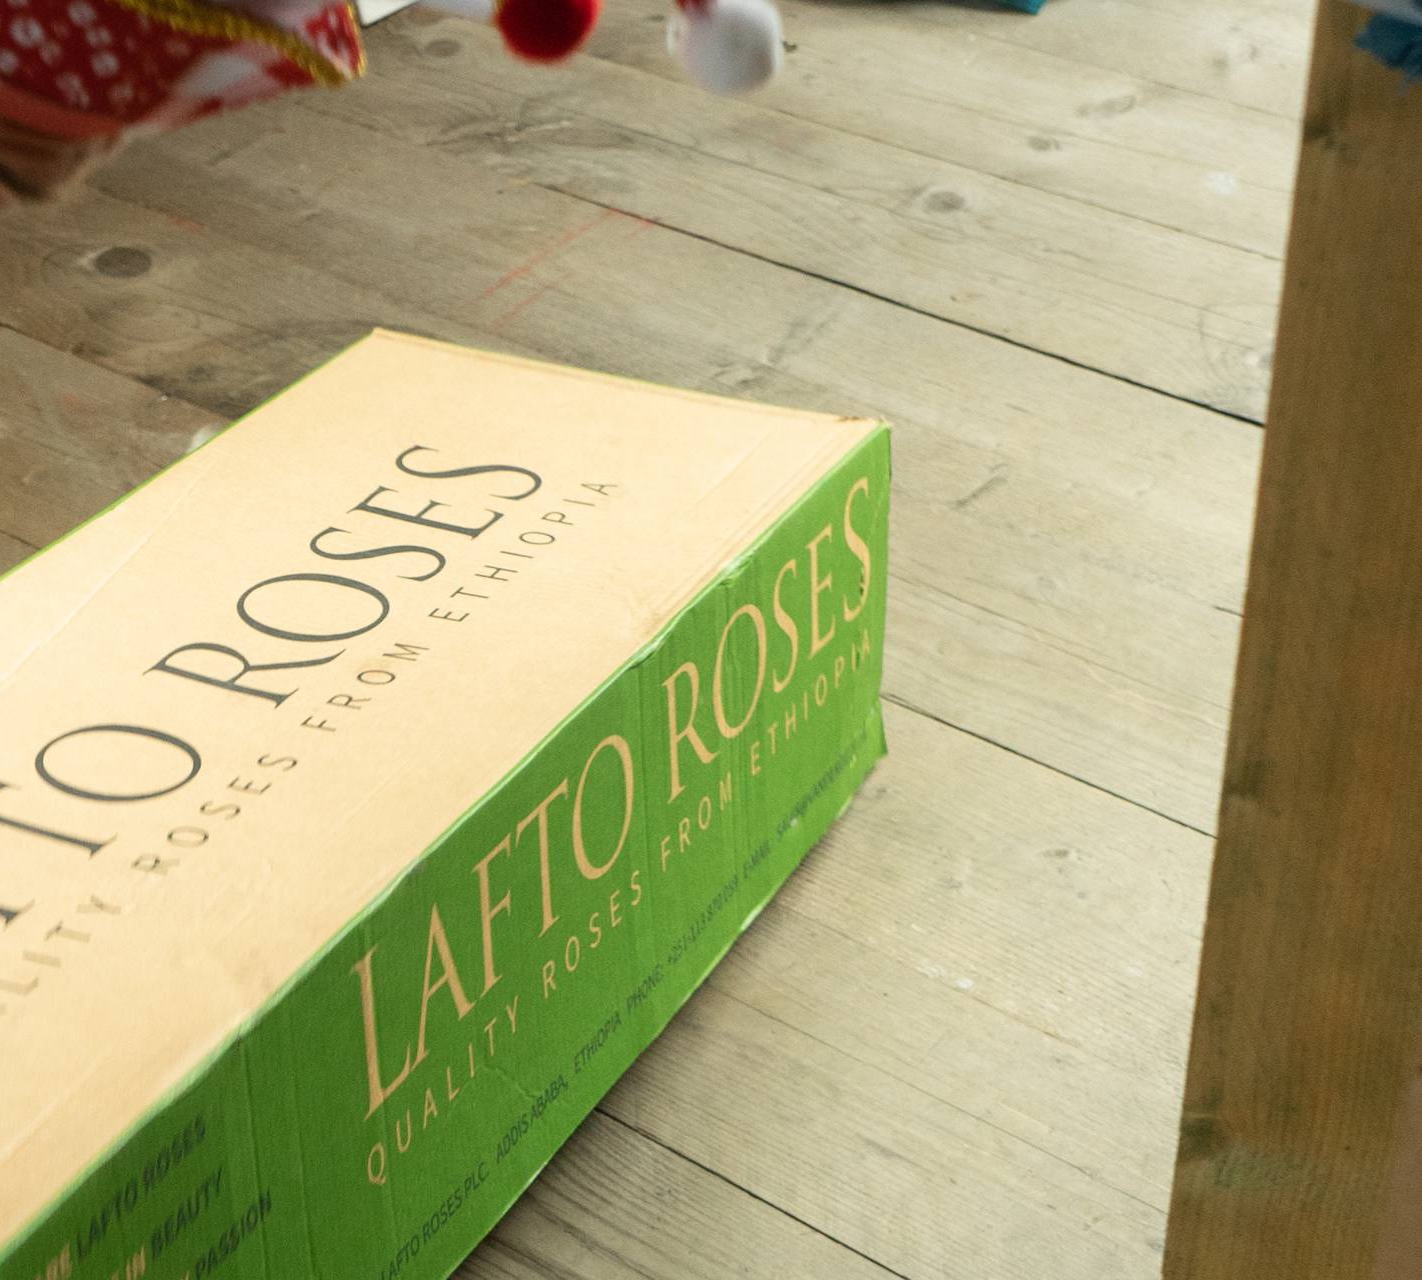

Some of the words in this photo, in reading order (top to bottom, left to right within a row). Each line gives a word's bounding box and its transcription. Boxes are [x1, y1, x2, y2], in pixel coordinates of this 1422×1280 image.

[131, 752, 298, 876] ROSES
[301, 642, 430, 732] FROM
[428, 480, 619, 623] ETHIOPIA
[143, 444, 543, 709] ROSES
[350, 734, 635, 1121] LAFTO
[662, 475, 871, 804] ROSES
[367, 994, 521, 1185] QUALITY
[542, 869, 643, 999] ROSES
[661, 770, 732, 874] FROM
[750, 627, 871, 777] ETHIOPIA
[422, 1187, 463, 1247] ROSES
[463, 1159, 490, 1201] PLC
[496, 1118, 530, 1164] ADDIS
[573, 1010, 623, 1075] ETHIOPIA
